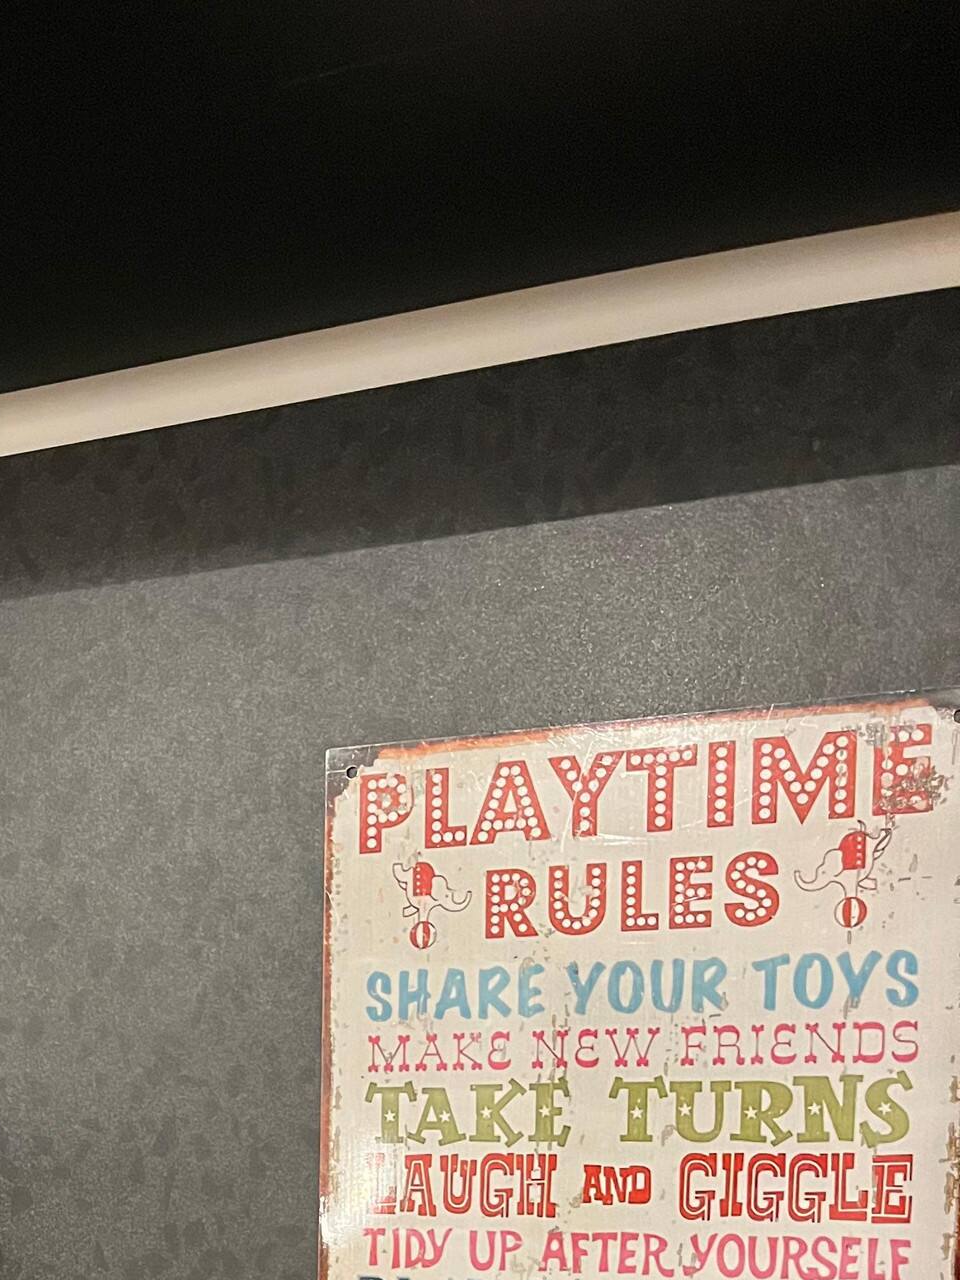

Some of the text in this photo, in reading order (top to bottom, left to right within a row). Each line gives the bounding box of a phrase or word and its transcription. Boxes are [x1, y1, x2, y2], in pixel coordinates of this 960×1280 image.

[359, 723, 934, 854] PLAYTIME
[484, 851, 780, 939] RULES
[365, 949, 920, 1022] SHARE YOUR TOYS
[366, 1020, 920, 1073] MAKE NEW FRIENDS
[364, 1071, 914, 1148] TAKE TURNS
[366, 1152, 914, 1224] LAUGH AND GIGGLE
[362, 1227, 452, 1269] TIDY
[469, 1229, 523, 1272] UP
[538, 1231, 675, 1278] AFTER
